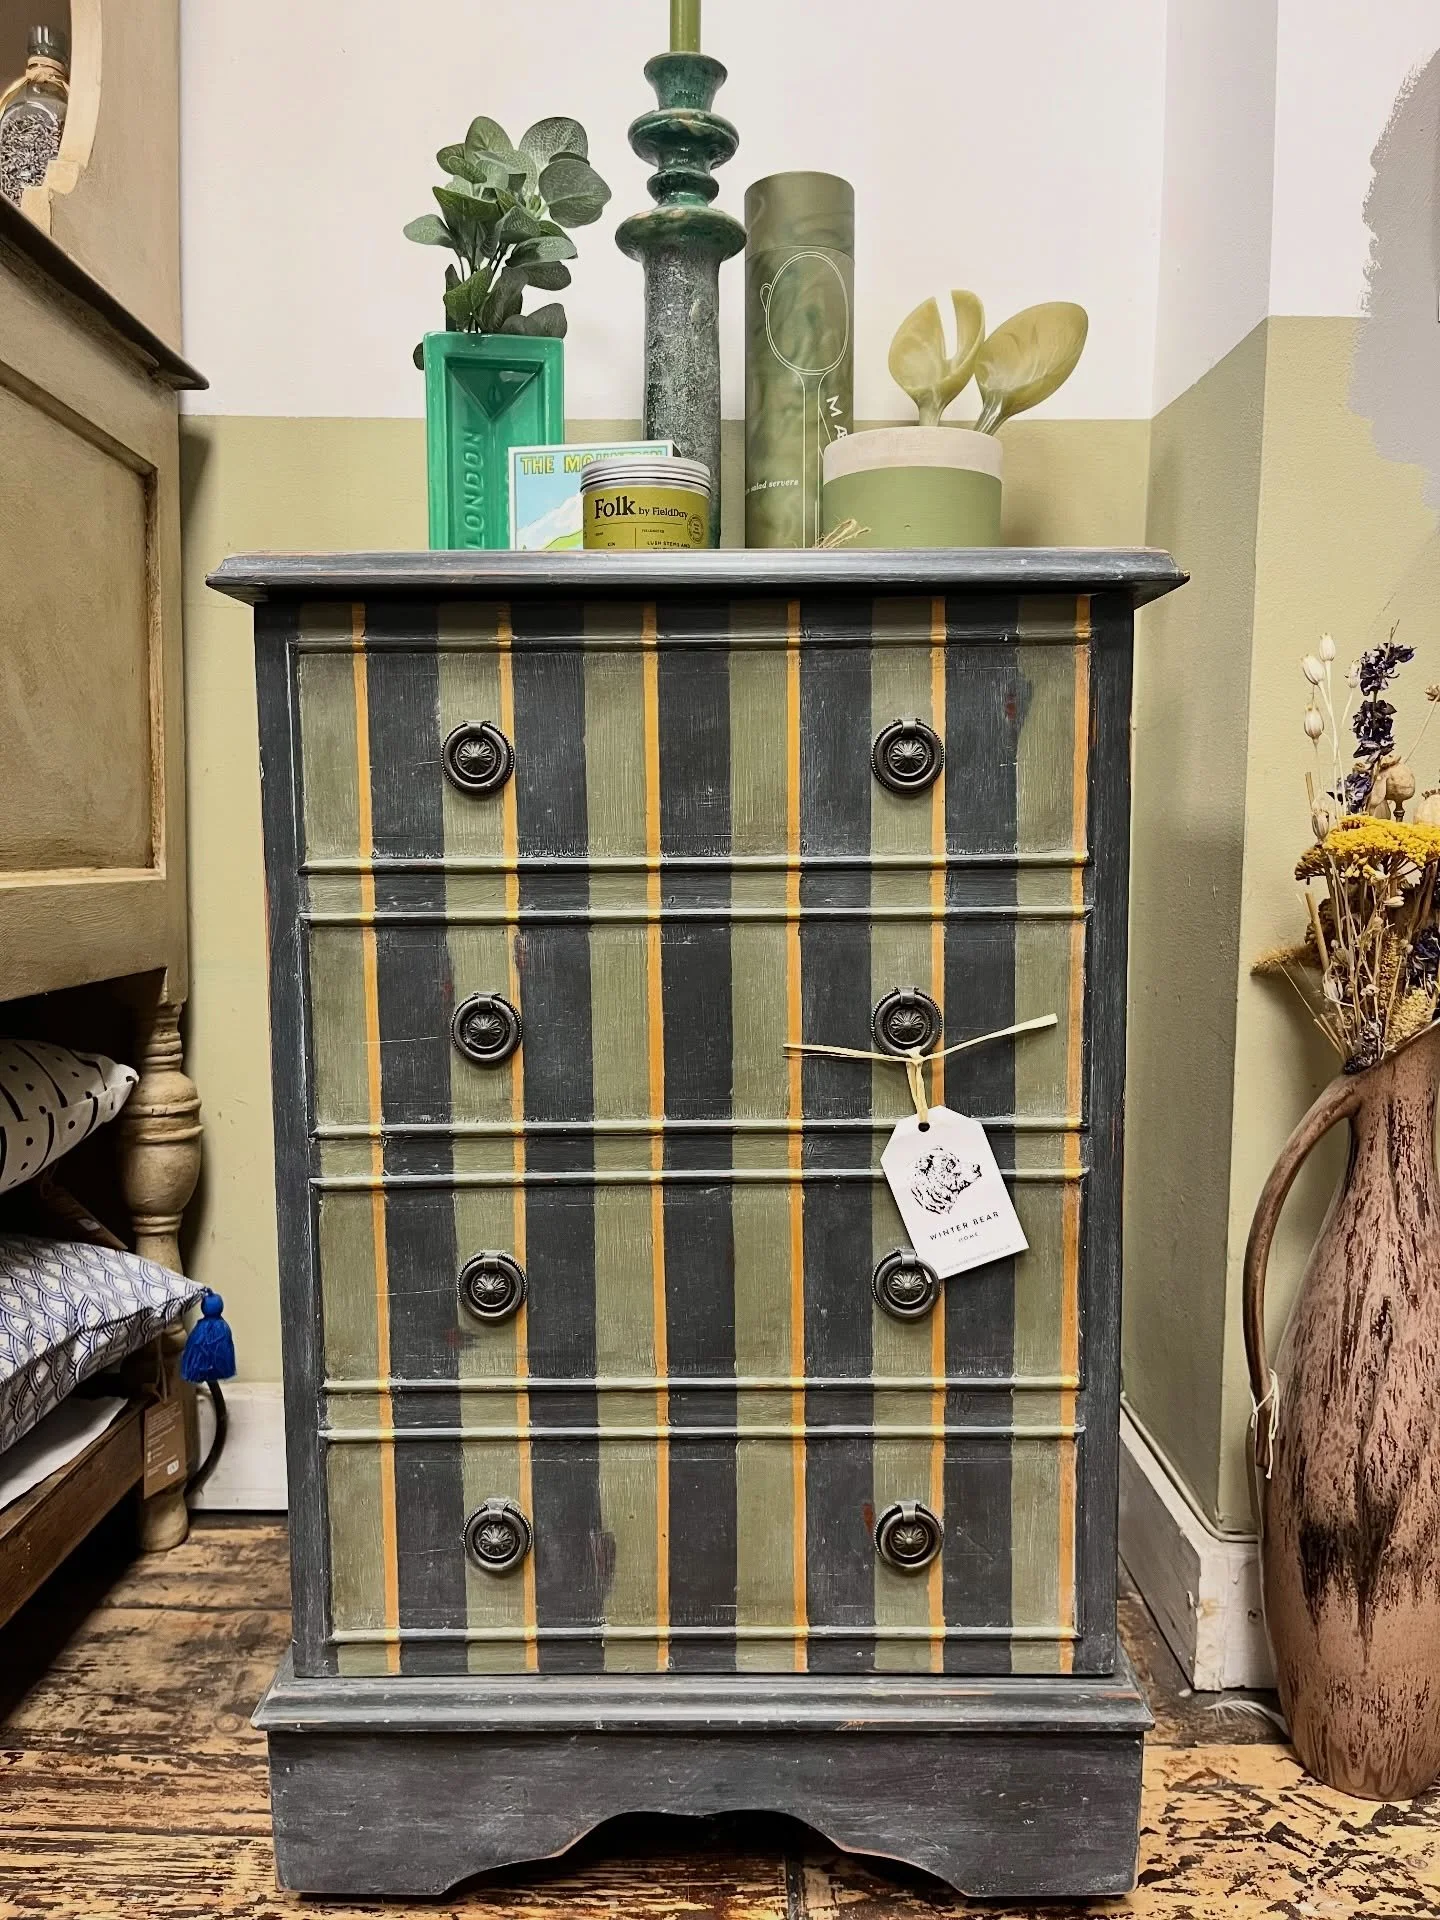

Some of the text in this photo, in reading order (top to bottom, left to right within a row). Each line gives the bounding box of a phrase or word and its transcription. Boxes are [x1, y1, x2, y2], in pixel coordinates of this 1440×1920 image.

[520, 455, 554, 475] THE
[463, 431, 485, 550] LONDON
[768, 479, 799, 488] servers
[594, 496, 688, 520] Folk by FieldDay
[929, 1211, 999, 1241] WINTER BEAR
